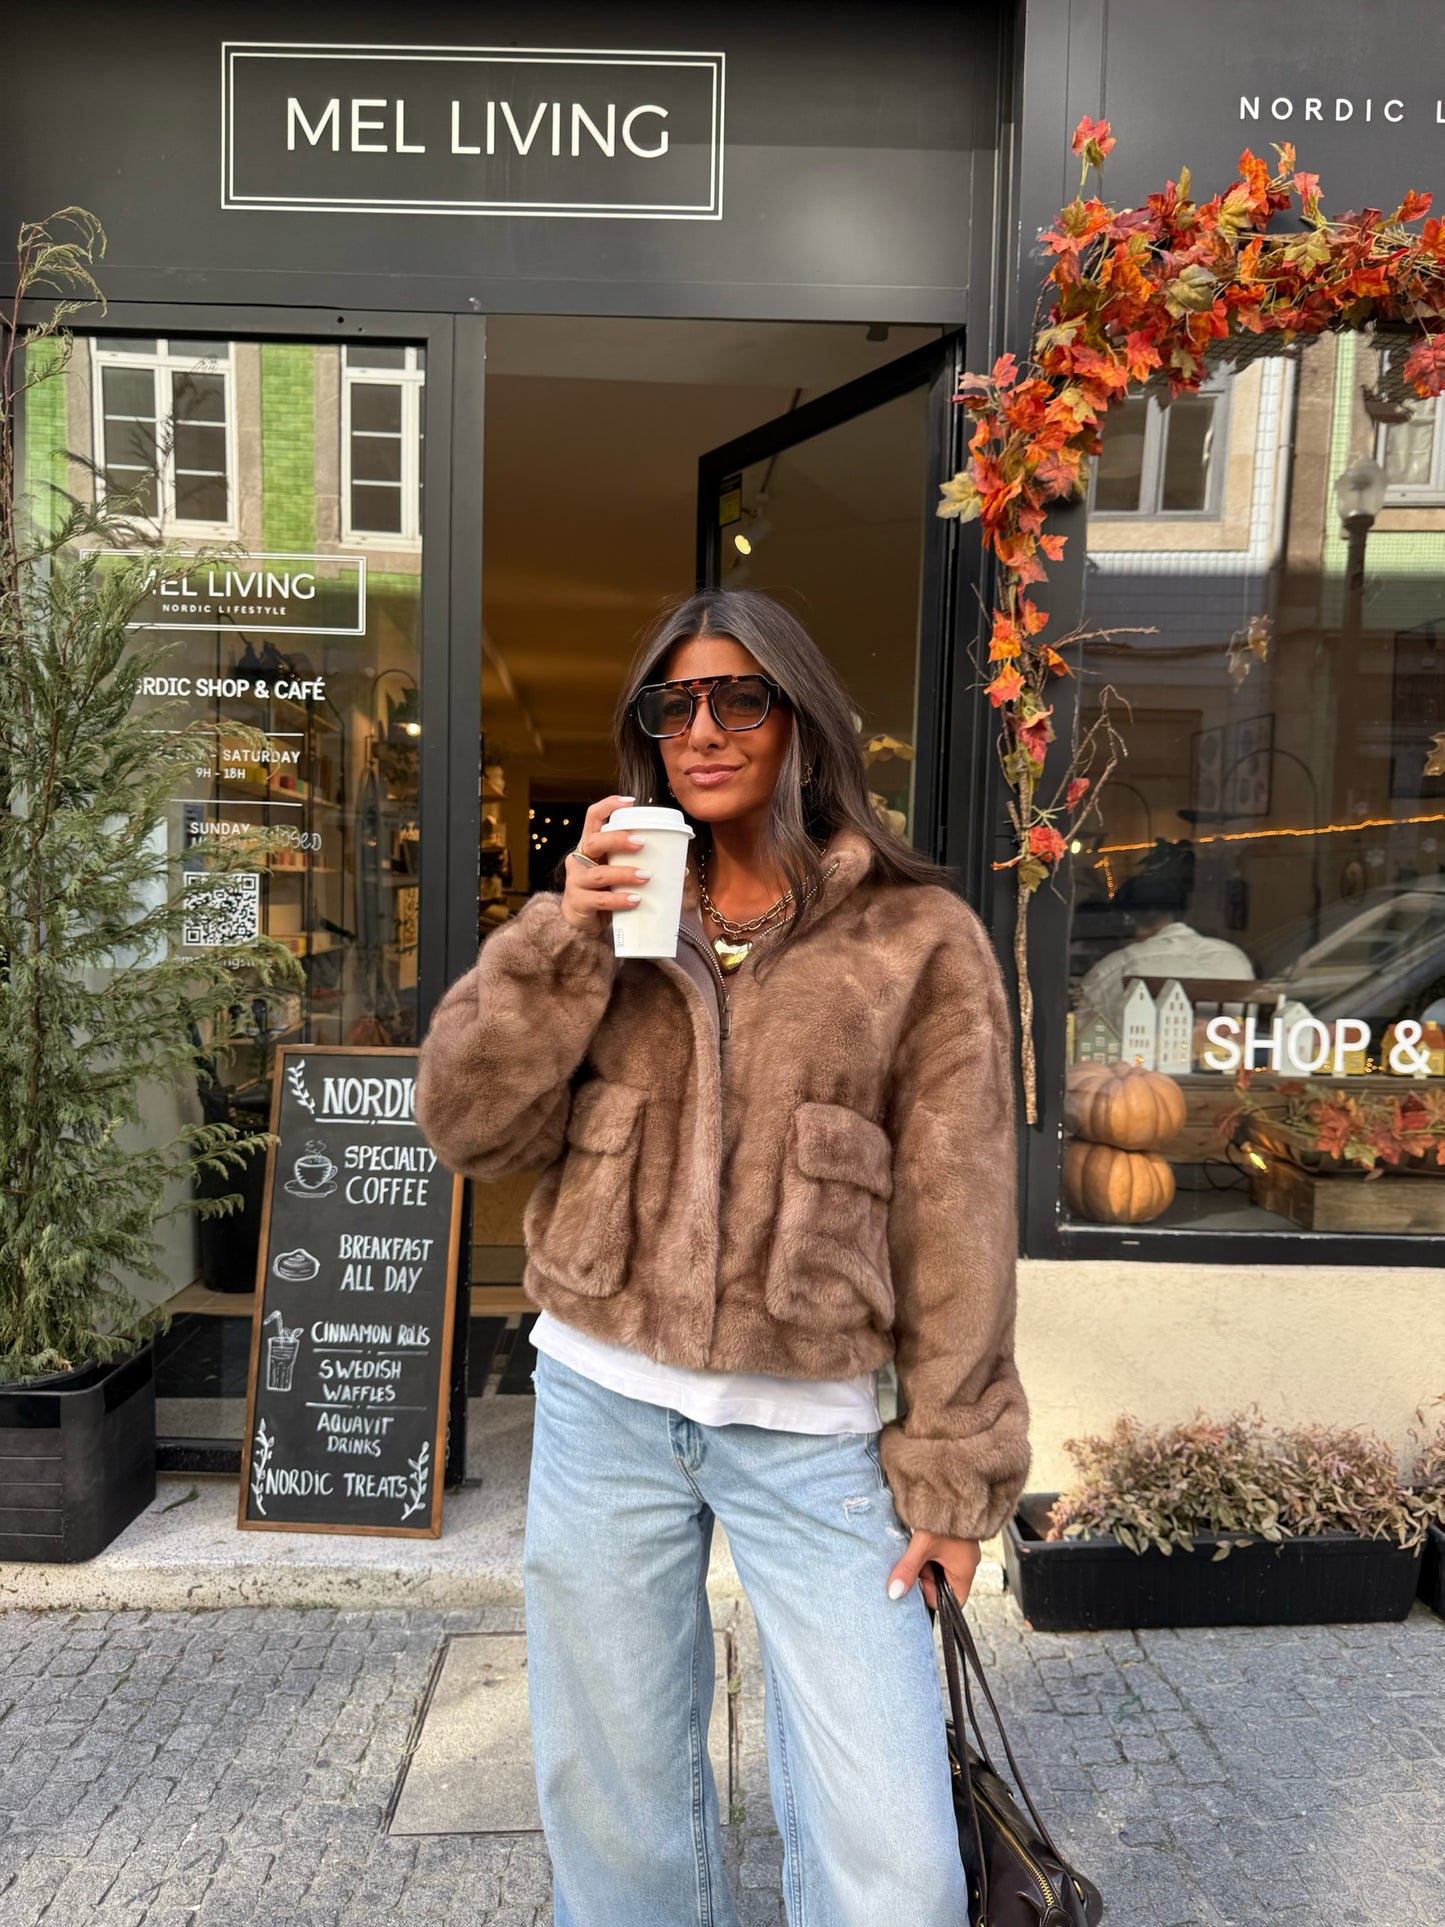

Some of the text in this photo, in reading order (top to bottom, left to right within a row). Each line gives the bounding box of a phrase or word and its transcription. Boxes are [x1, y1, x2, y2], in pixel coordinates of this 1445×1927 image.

[1238, 96, 1406, 123] NORDIC
[286, 97, 670, 158] MEL LIVING
[208, 570, 317, 600] LIVING
[162, 604, 287, 616] NORDIC LIFESTYLE
[195, 679, 250, 699] SHOP
[253, 680, 270, 699] &
[274, 676, 326, 701] CAFÉ
[222, 749, 301, 764] SATURDAY
[195, 767, 211, 779] 9H
[223, 768, 246, 780] 18H
[190, 822, 250, 835] SUNDAY
[1203, 1016, 1431, 1074] SHOP &
[344, 1145, 438, 1173] SPECIALTY
[345, 1175, 429, 1206] COFFEE
[338, 1233, 434, 1262] BREAKFAST
[340, 1264, 423, 1294] ALL DAY
[310, 1321, 393, 1345] CINNAMON
[322, 1383, 397, 1403] WAFFLES
[342, 1472, 409, 1499] TREATS
